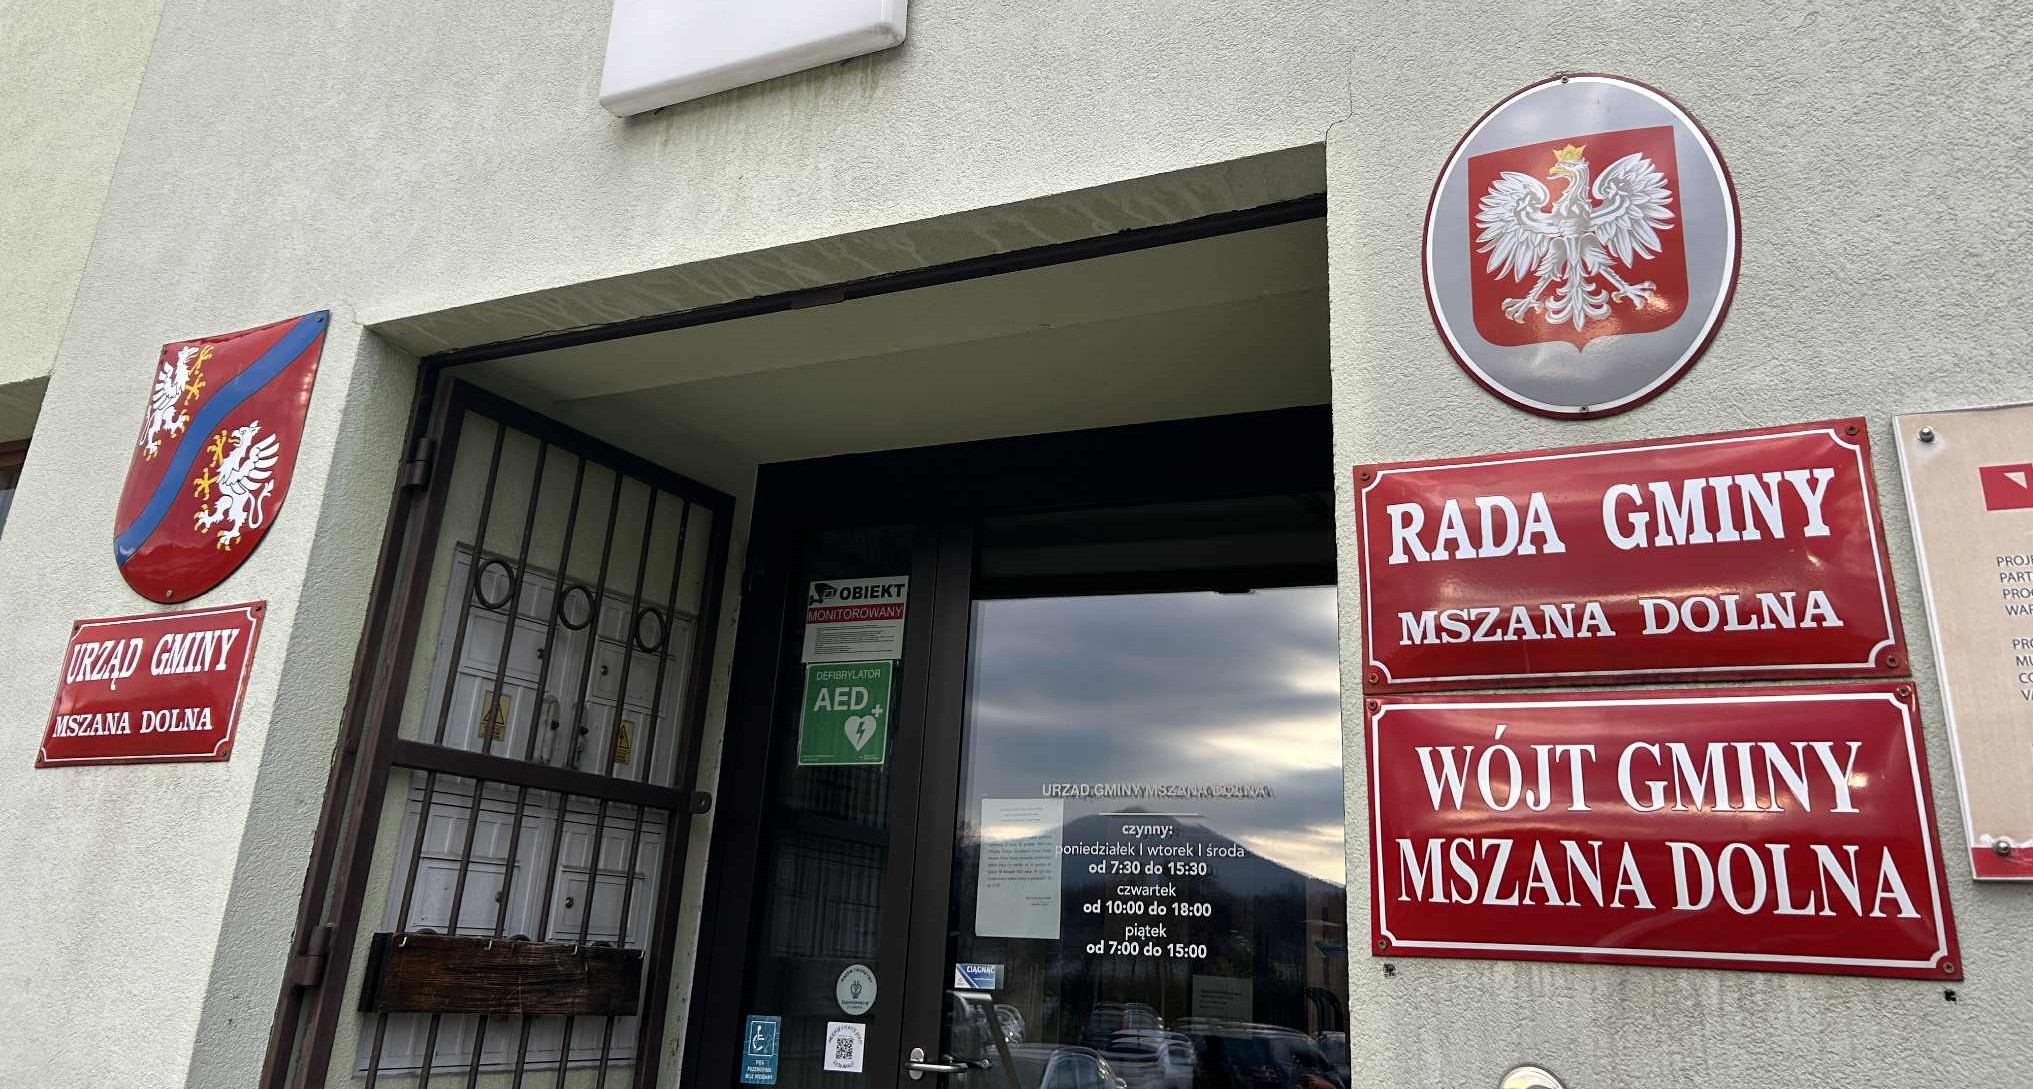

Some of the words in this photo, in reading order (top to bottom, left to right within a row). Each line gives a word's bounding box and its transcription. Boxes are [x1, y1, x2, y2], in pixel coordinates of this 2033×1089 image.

[1386, 491, 1566, 565] RADA
[1602, 467, 1835, 551] GMINY
[839, 583, 906, 601] OBIEKT
[808, 606, 904, 622] MONITOROWANY
[1398, 602, 1616, 645] MSZANA
[1642, 590, 1844, 635] DOLNA
[66, 638, 143, 691] URZĄD
[151, 628, 240, 676] GMINY
[816, 668, 881, 681] DEFIBRYLATOR
[813, 686, 869, 712] AED
[53, 712, 131, 738] MSZANA
[140, 707, 213, 733] DOLNA
[1415, 725, 1597, 812] WÓJT
[1617, 741, 1863, 814] GMINY
[1042, 784, 1090, 798] URZĄD
[1094, 784, 1141, 797] GMINY
[1122, 824, 1173, 838] czynny:
[1056, 842, 1135, 857] poniedziałek
[1147, 843, 1193, 857] wtorek
[1206, 843, 1245, 857] środa
[1088, 861, 1106, 874] od
[1110, 861, 1140, 874] 7:30
[1144, 861, 1163, 875] do
[1168, 862, 1208, 875] 15:30
[1396, 838, 1656, 910] MSZANA
[1665, 841, 1921, 919] DOLNA
[1117, 883, 1176, 897] czwartek
[1083, 900, 1101, 914] od
[1106, 901, 1144, 915] 10:00
[1149, 901, 1167, 916] do
[1172, 903, 1212, 917] 18:00
[1125, 923, 1167, 940] piątek
[1087, 941, 1104, 954] od
[1109, 941, 1139, 955] 7:00
[1143, 941, 1162, 956] do
[1167, 944, 1207, 958] 15:00
